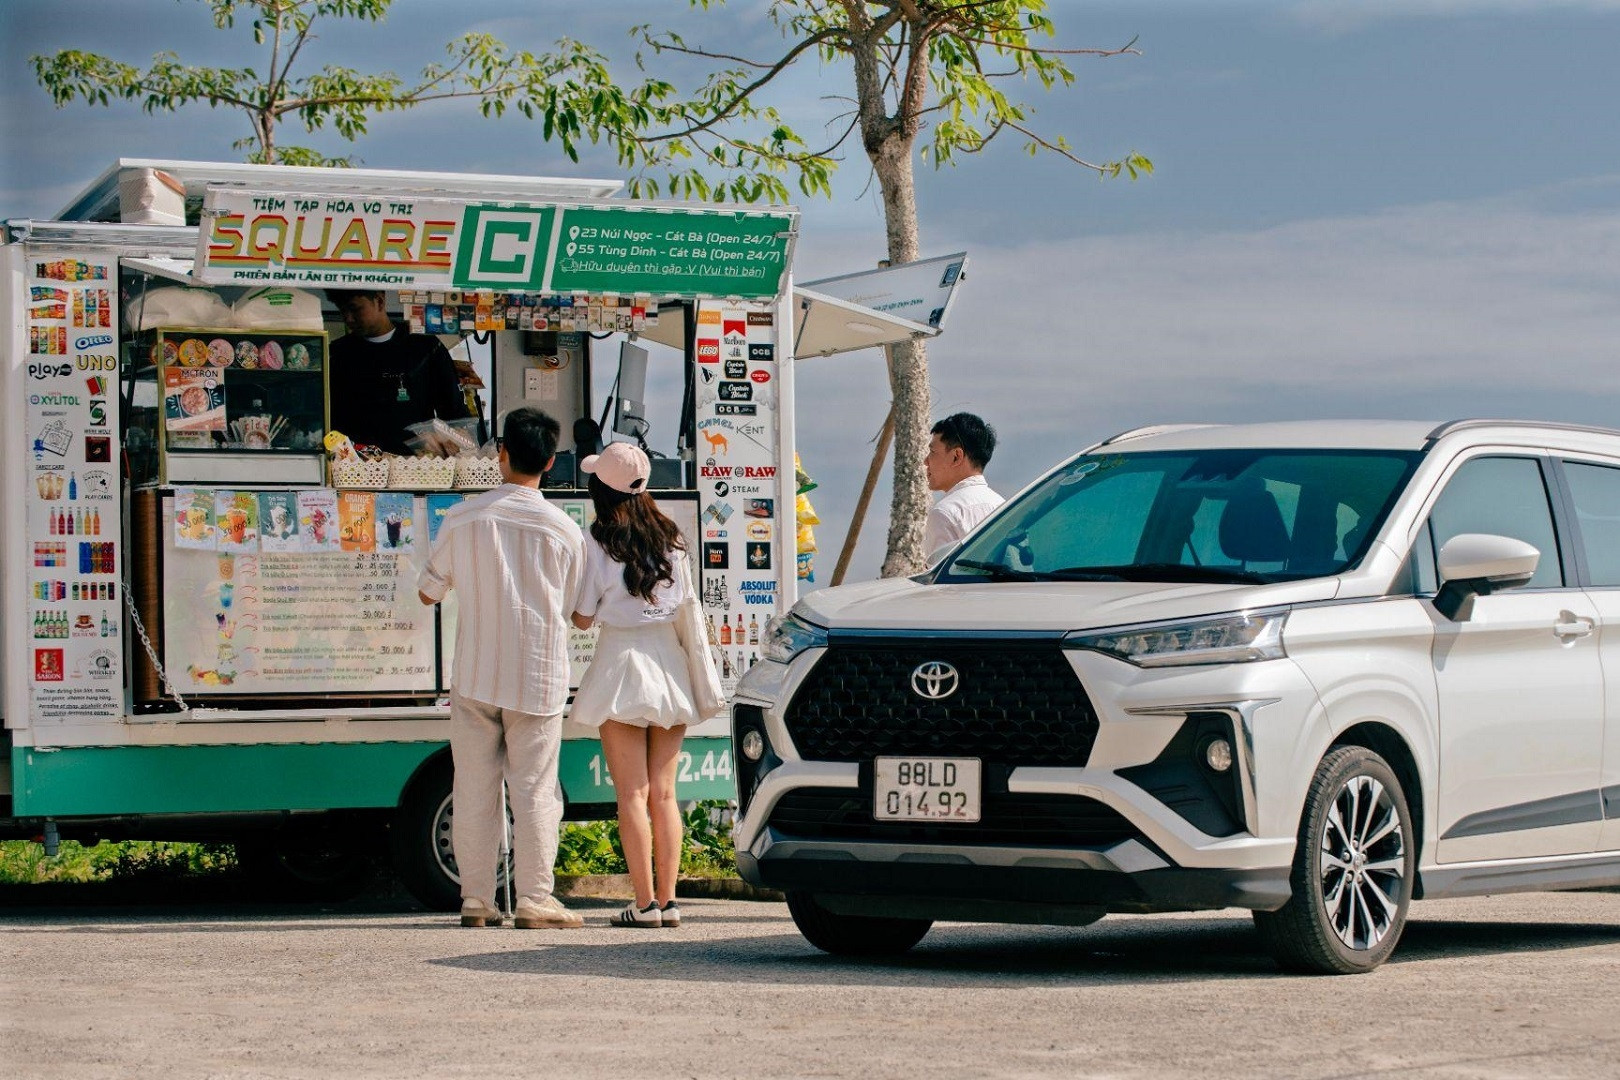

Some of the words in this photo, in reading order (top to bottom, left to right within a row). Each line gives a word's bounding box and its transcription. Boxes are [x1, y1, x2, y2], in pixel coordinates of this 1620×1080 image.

[253, 198, 286, 212] TIỆM
[294, 200, 320, 213] TẠP
[389, 203, 413, 215] TRI
[208, 214, 456, 265] SQUARE
[580, 228, 597, 238] 23
[601, 228, 621, 239] Núi
[623, 229, 653, 242] Ngọc
[665, 231, 685, 242] Cát
[688, 231, 703, 242] Bà
[578, 244, 594, 254] 55
[598, 245, 627, 257] Tùng
[630, 246, 656, 256] Dinh
[669, 247, 689, 258] Cát
[691, 248, 707, 258] Bà
[580, 260, 603, 271] Hữu
[605, 261, 641, 274] duyên
[233, 270, 270, 280] PHIÊN
[273, 271, 297, 281] BẢN
[324, 273, 338, 282] ĐI
[341, 273, 362, 282] TÌM
[364, 273, 403, 284] KHÁCH
[76, 336, 113, 349] OREO
[699, 345, 718, 356] LEGO
[752, 348, 771, 356] OCB
[77, 355, 116, 371] UNO
[41, 395, 80, 405] XYLITOL
[718, 405, 740, 413] OCB
[698, 418, 734, 430] CAMEL
[700, 466, 733, 477] RAW
[744, 466, 777, 478] RAW
[740, 581, 777, 591] ABSOLUT
[744, 594, 774, 605] VODKA
[898, 761, 957, 787] 88LD
[886, 790, 967, 817] 014.92
